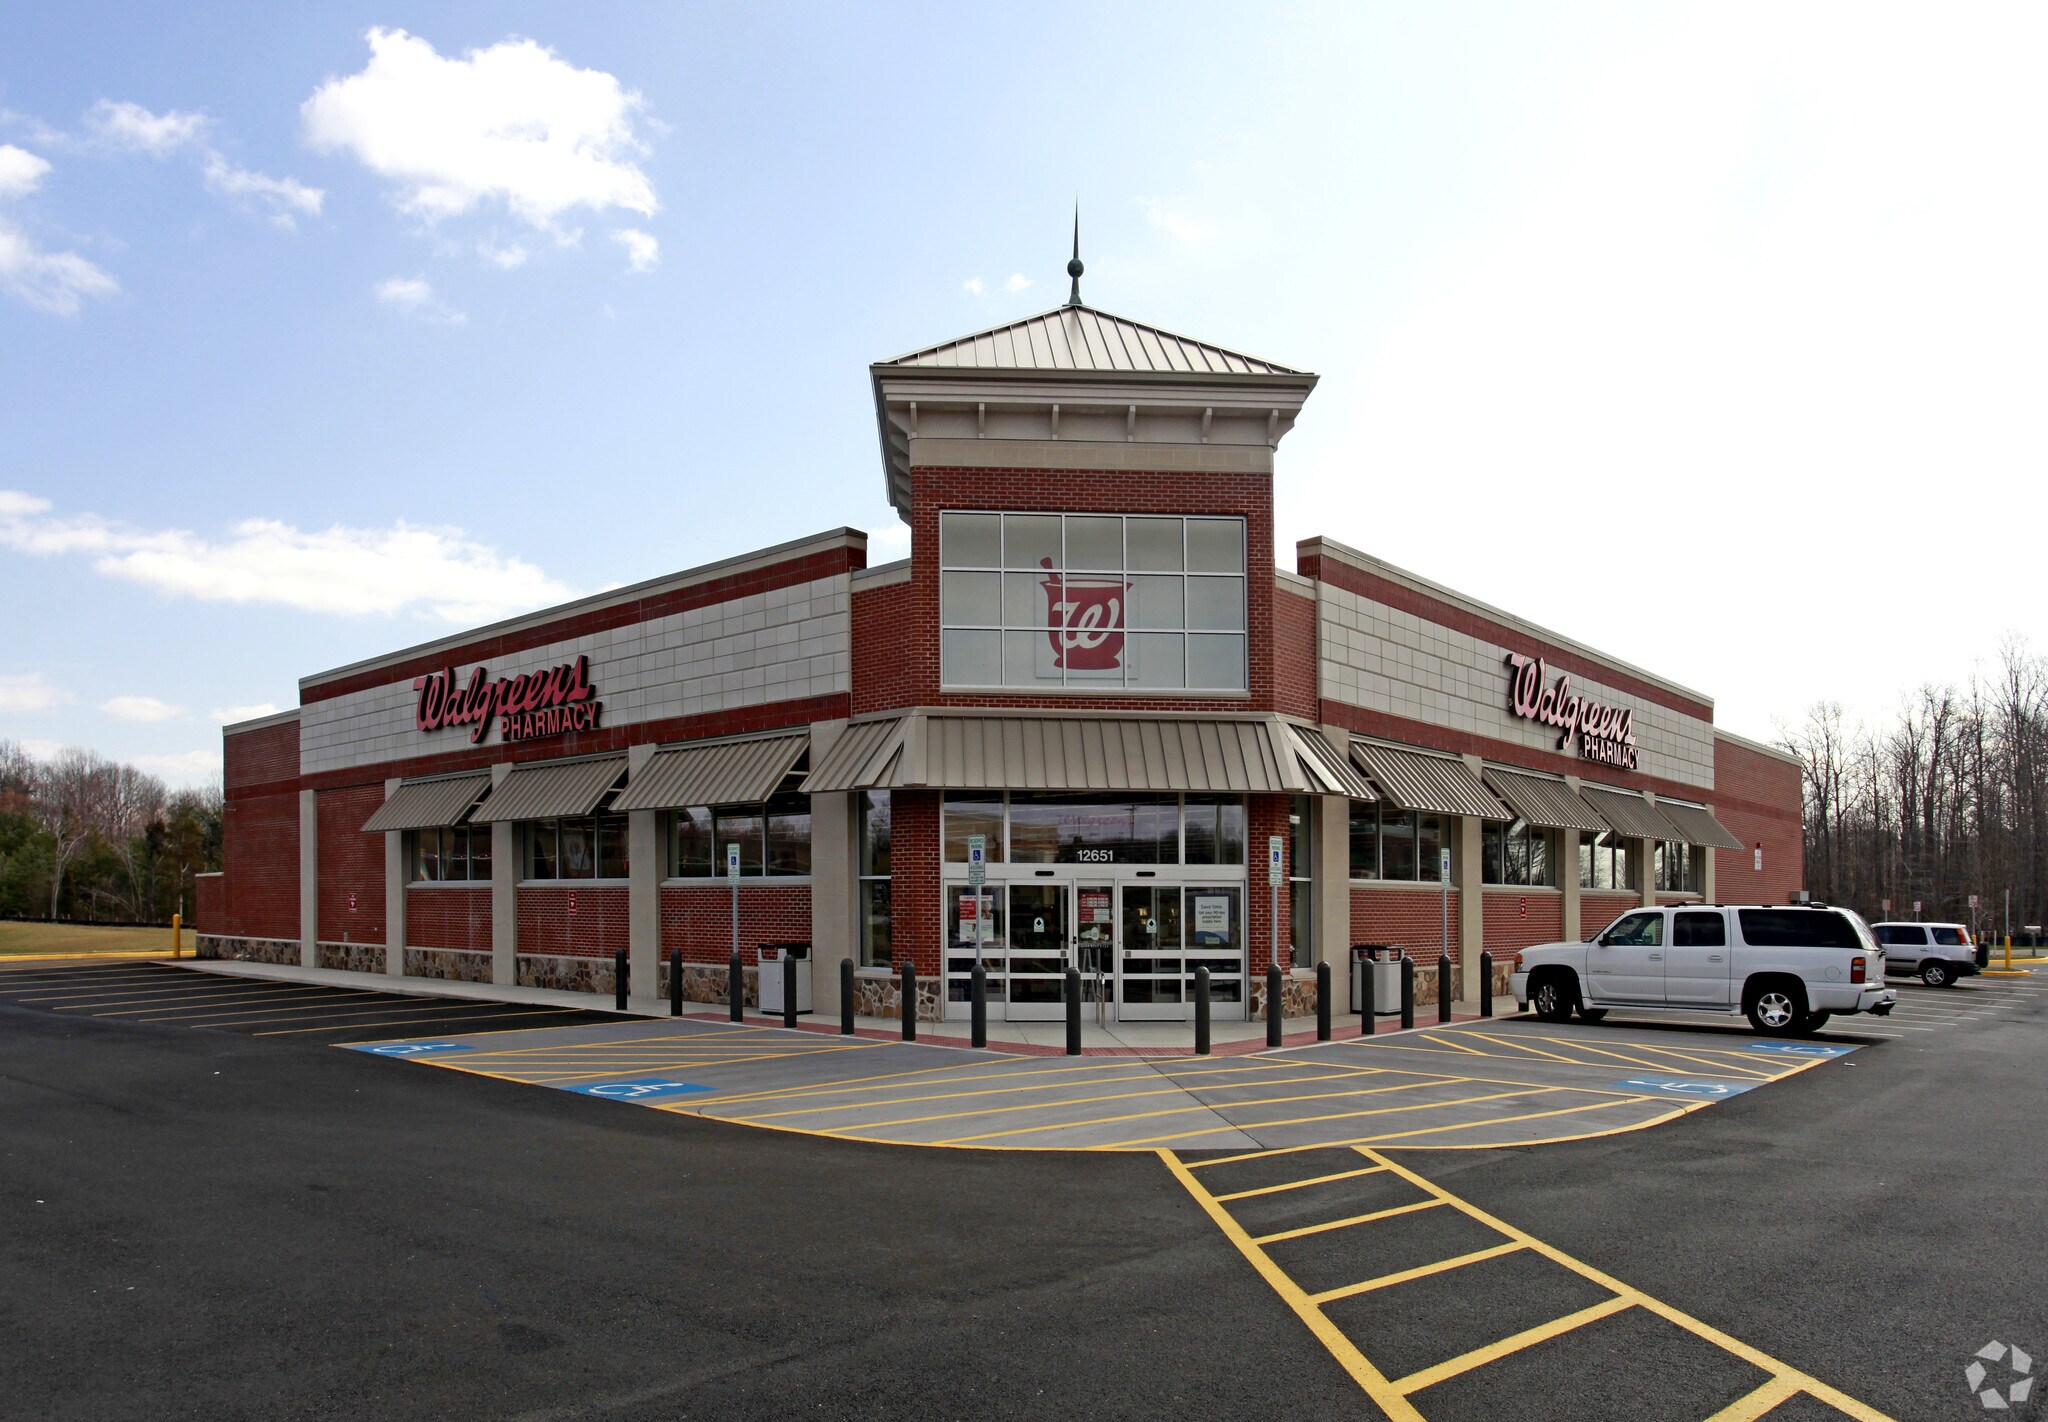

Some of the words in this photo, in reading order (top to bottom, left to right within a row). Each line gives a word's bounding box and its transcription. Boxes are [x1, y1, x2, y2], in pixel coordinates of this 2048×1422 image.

[413, 655, 593, 743] Walgreens
[1509, 653, 1636, 749] Walgreens
[501, 702, 600, 741] PHARMACY
[1583, 734, 1640, 769] PHARMACY
[1077, 850, 1113, 862] 12651
